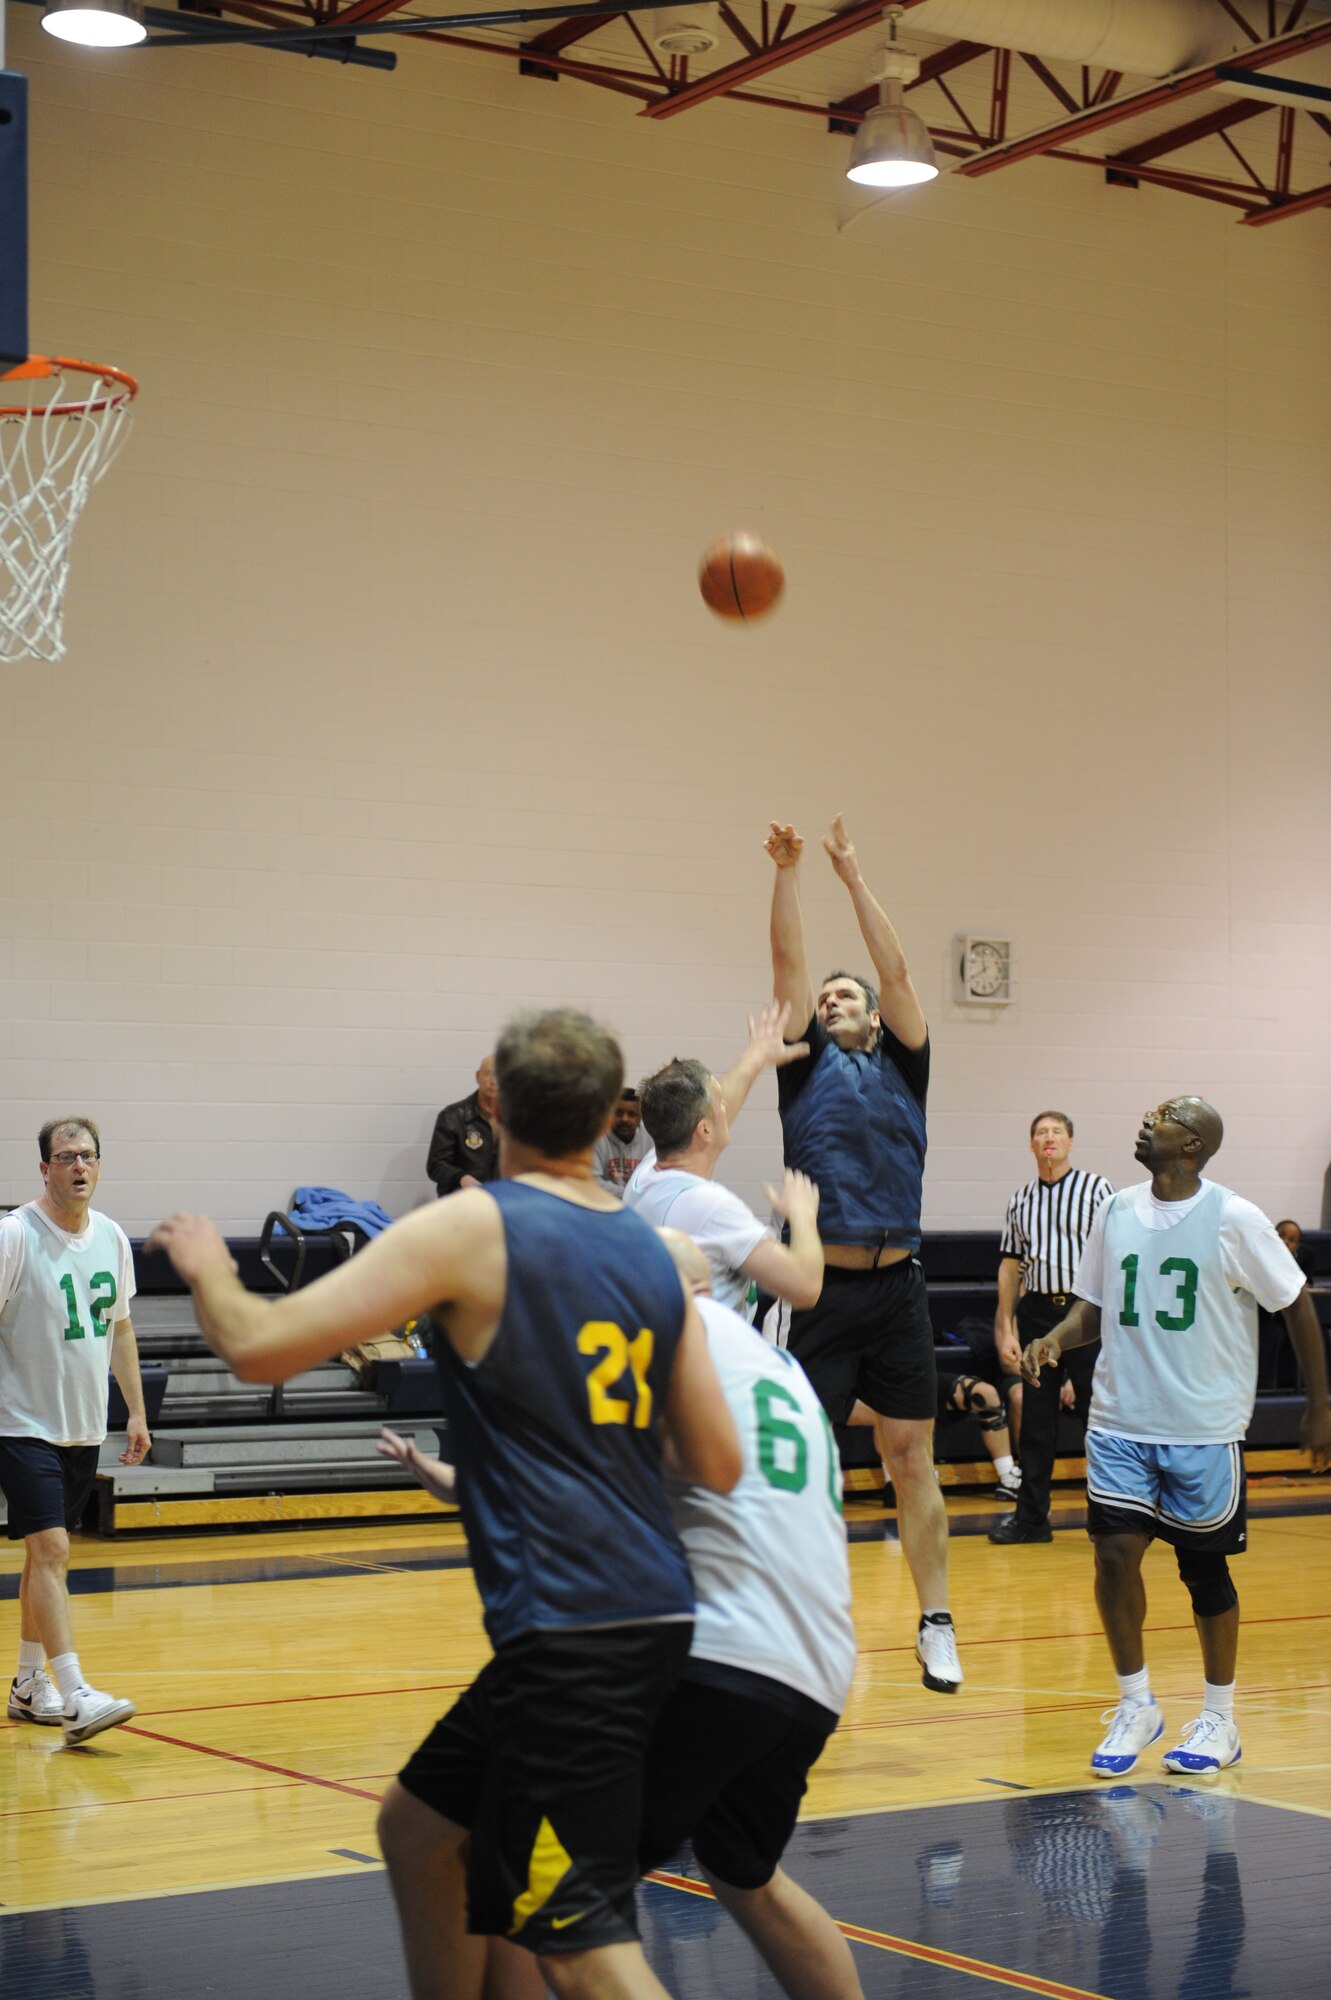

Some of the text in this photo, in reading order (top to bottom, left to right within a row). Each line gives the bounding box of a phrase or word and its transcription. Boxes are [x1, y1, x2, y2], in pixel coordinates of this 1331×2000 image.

[59, 1271, 117, 1341] 12
[1119, 1253, 1199, 1332] 13
[576, 1320, 654, 1429] 21
